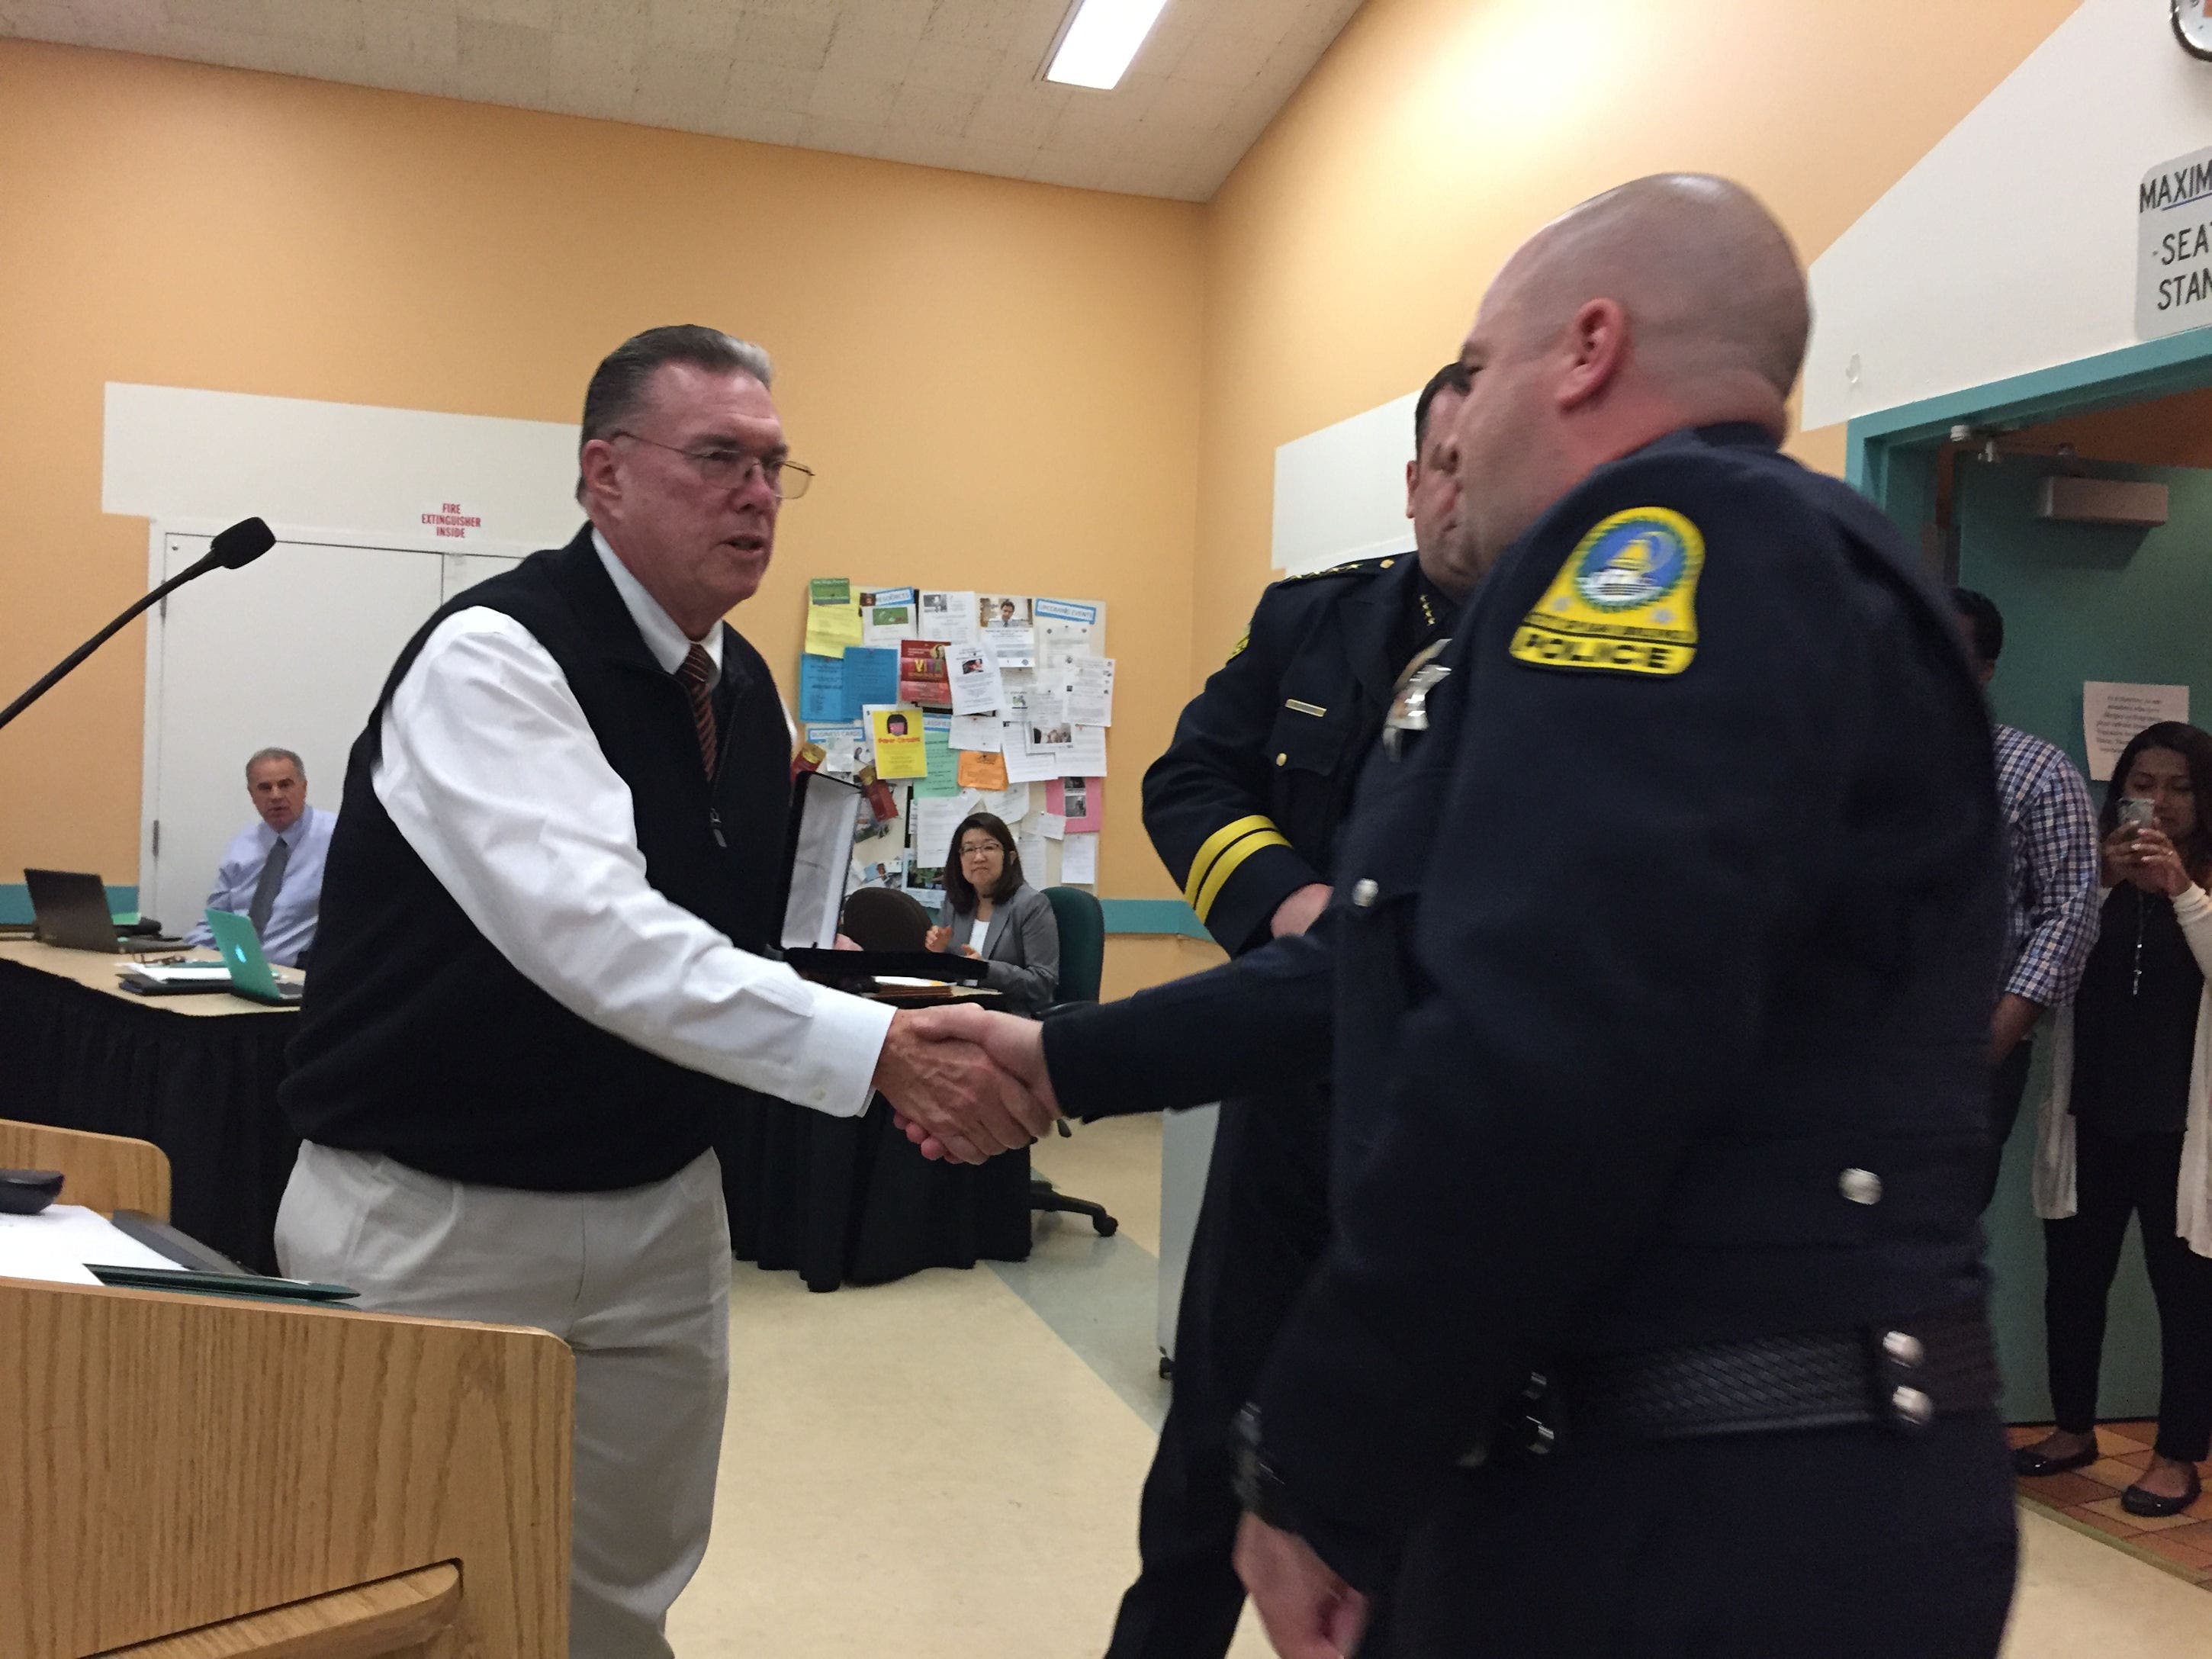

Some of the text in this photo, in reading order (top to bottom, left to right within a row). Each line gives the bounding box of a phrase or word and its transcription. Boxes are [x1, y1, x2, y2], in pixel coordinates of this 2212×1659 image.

[2140, 159, 2212, 214] MAXIM
[2161, 222, 2212, 265] SEA
[421, 513, 481, 527] EXTINGUISHER
[442, 503, 461, 514] FIRE
[436, 526, 465, 538] INSIDE
[1525, 632, 1670, 668] POLICE
